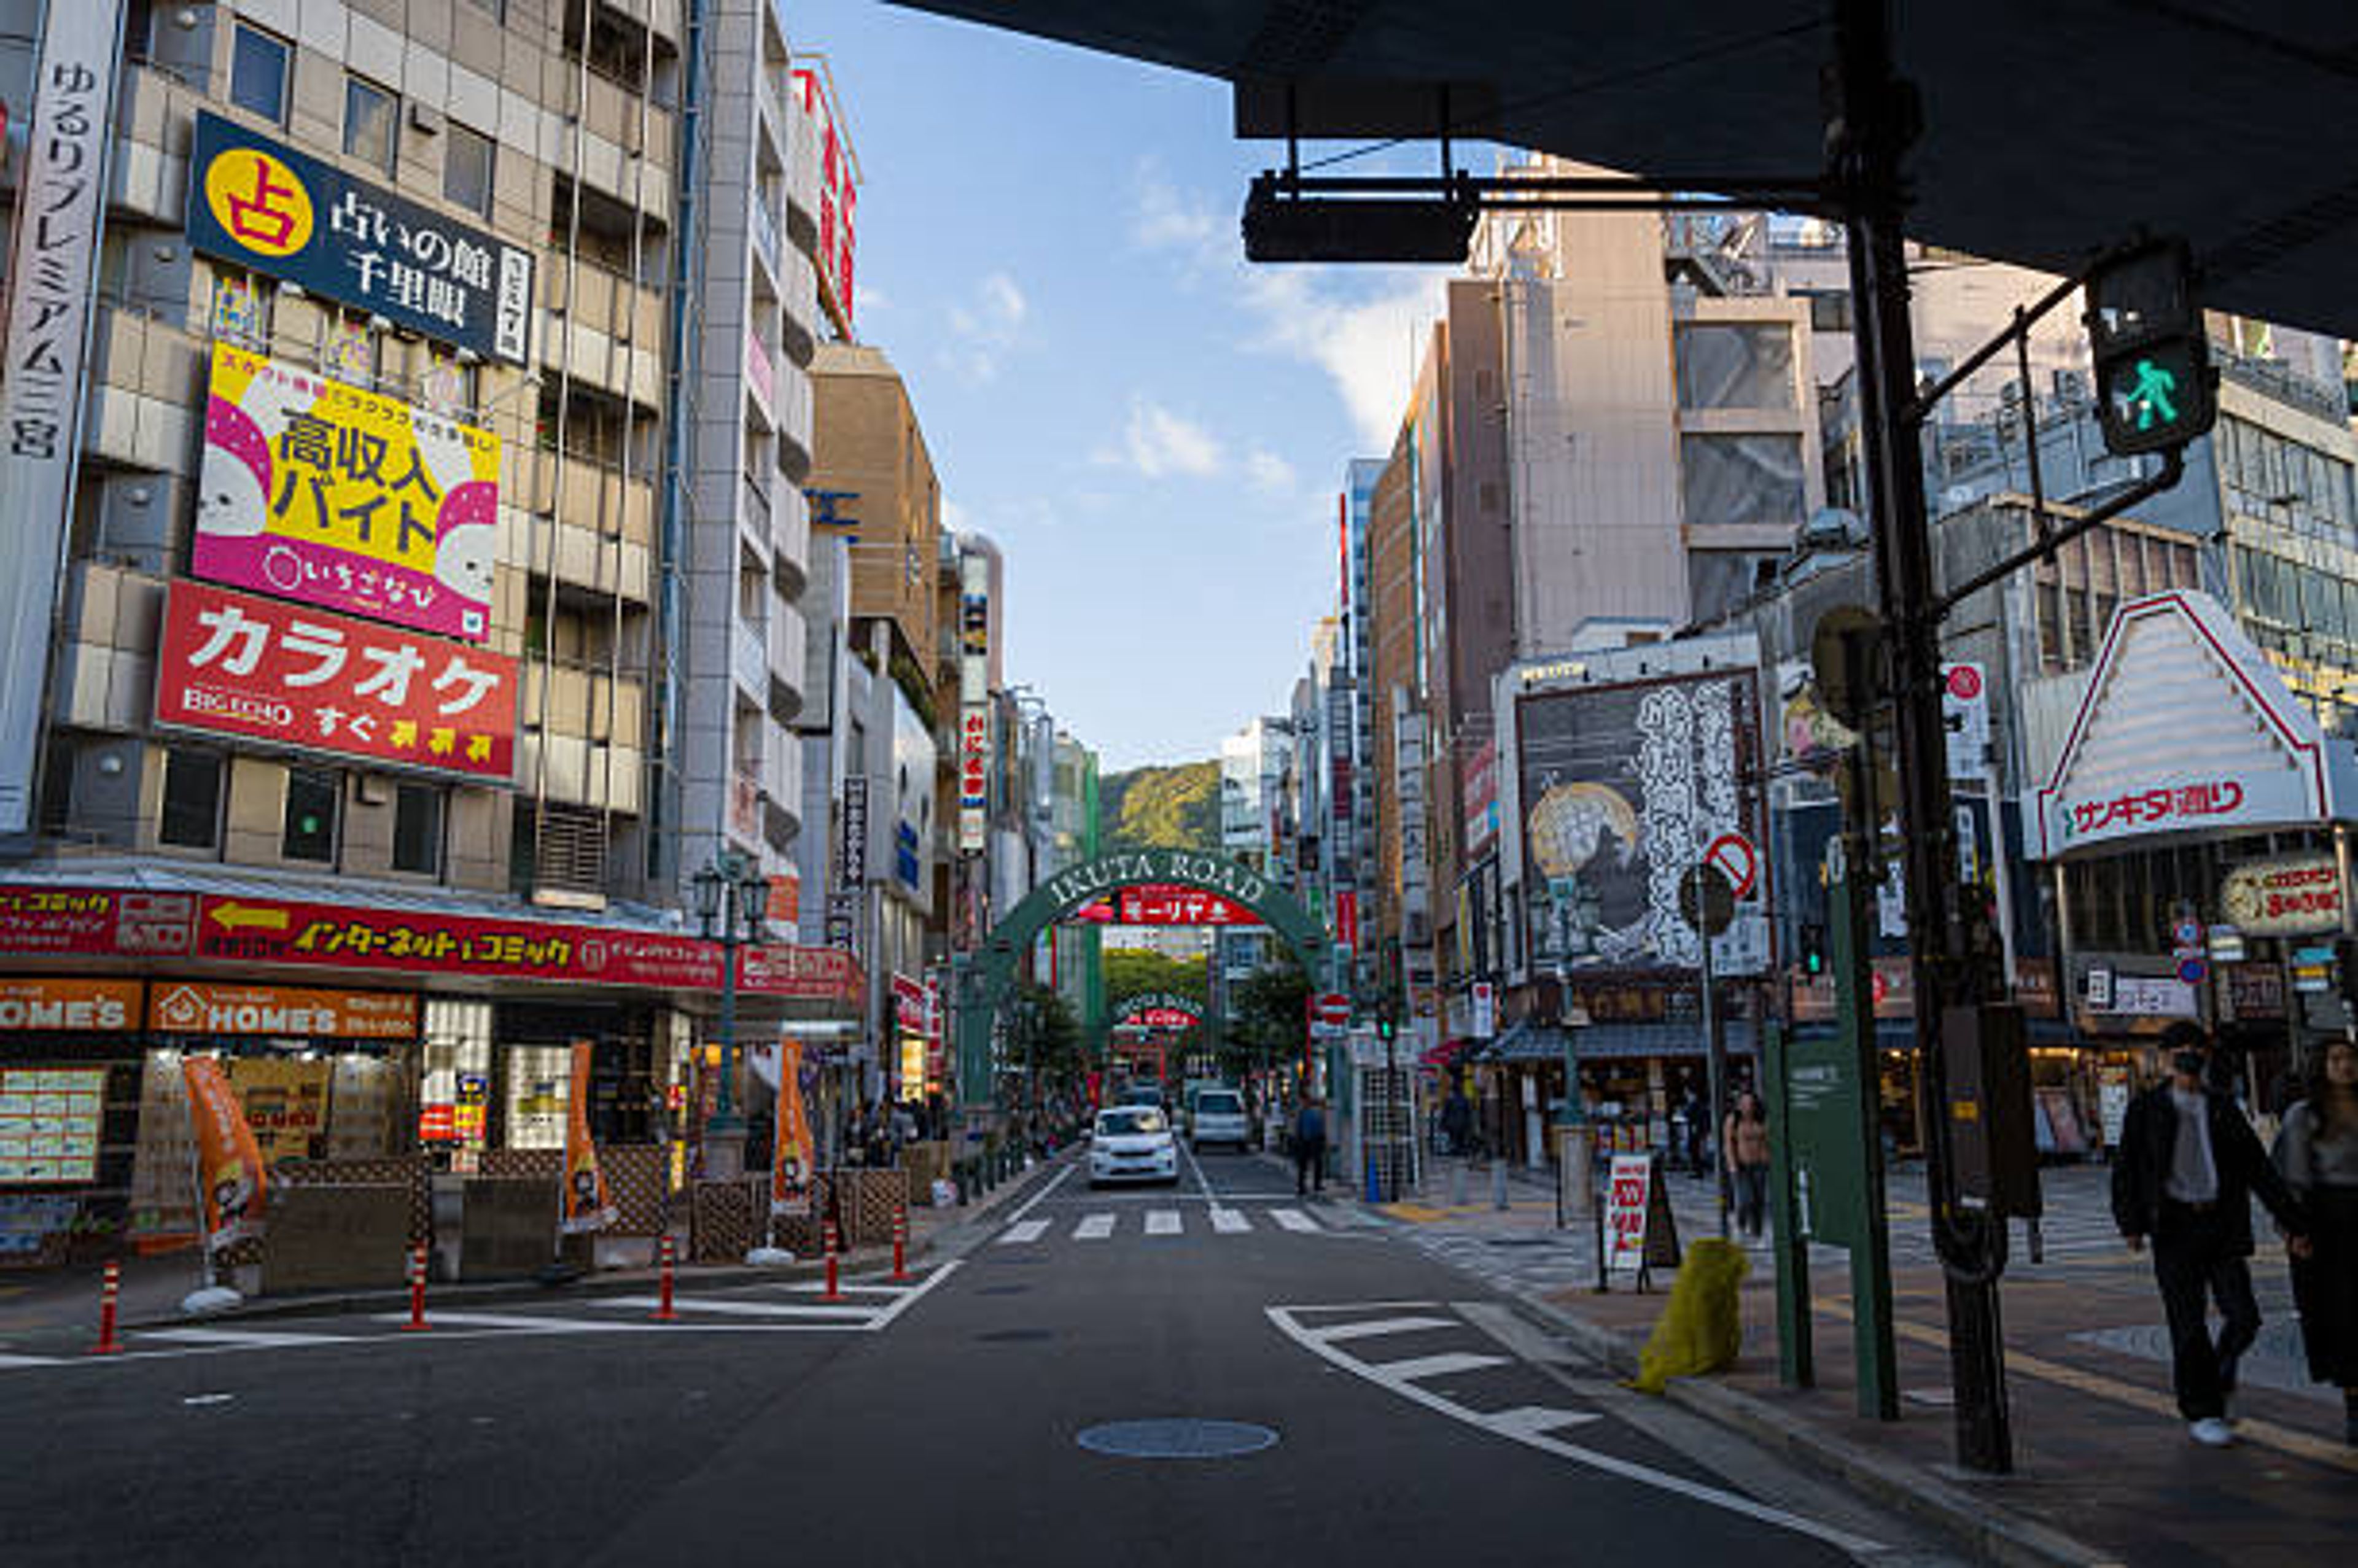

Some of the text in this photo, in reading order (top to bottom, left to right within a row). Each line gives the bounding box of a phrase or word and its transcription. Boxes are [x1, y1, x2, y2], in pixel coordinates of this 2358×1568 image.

[226, 157, 296, 248] 占
[331, 192, 492, 290] 占いの館
[347, 250, 467, 329] 千里眼
[281, 407, 438, 502] 高収入
[273, 470, 435, 553] バイト
[306, 561, 435, 607] いちごなび
[189, 605, 499, 715] カラオケ
[314, 707, 377, 742] すぐ
[2074, 781, 2244, 833] サンキタ通り
[1050, 854, 1266, 905] IKUTA ROAD
[209, 1001, 337, 1033] HOME'S
